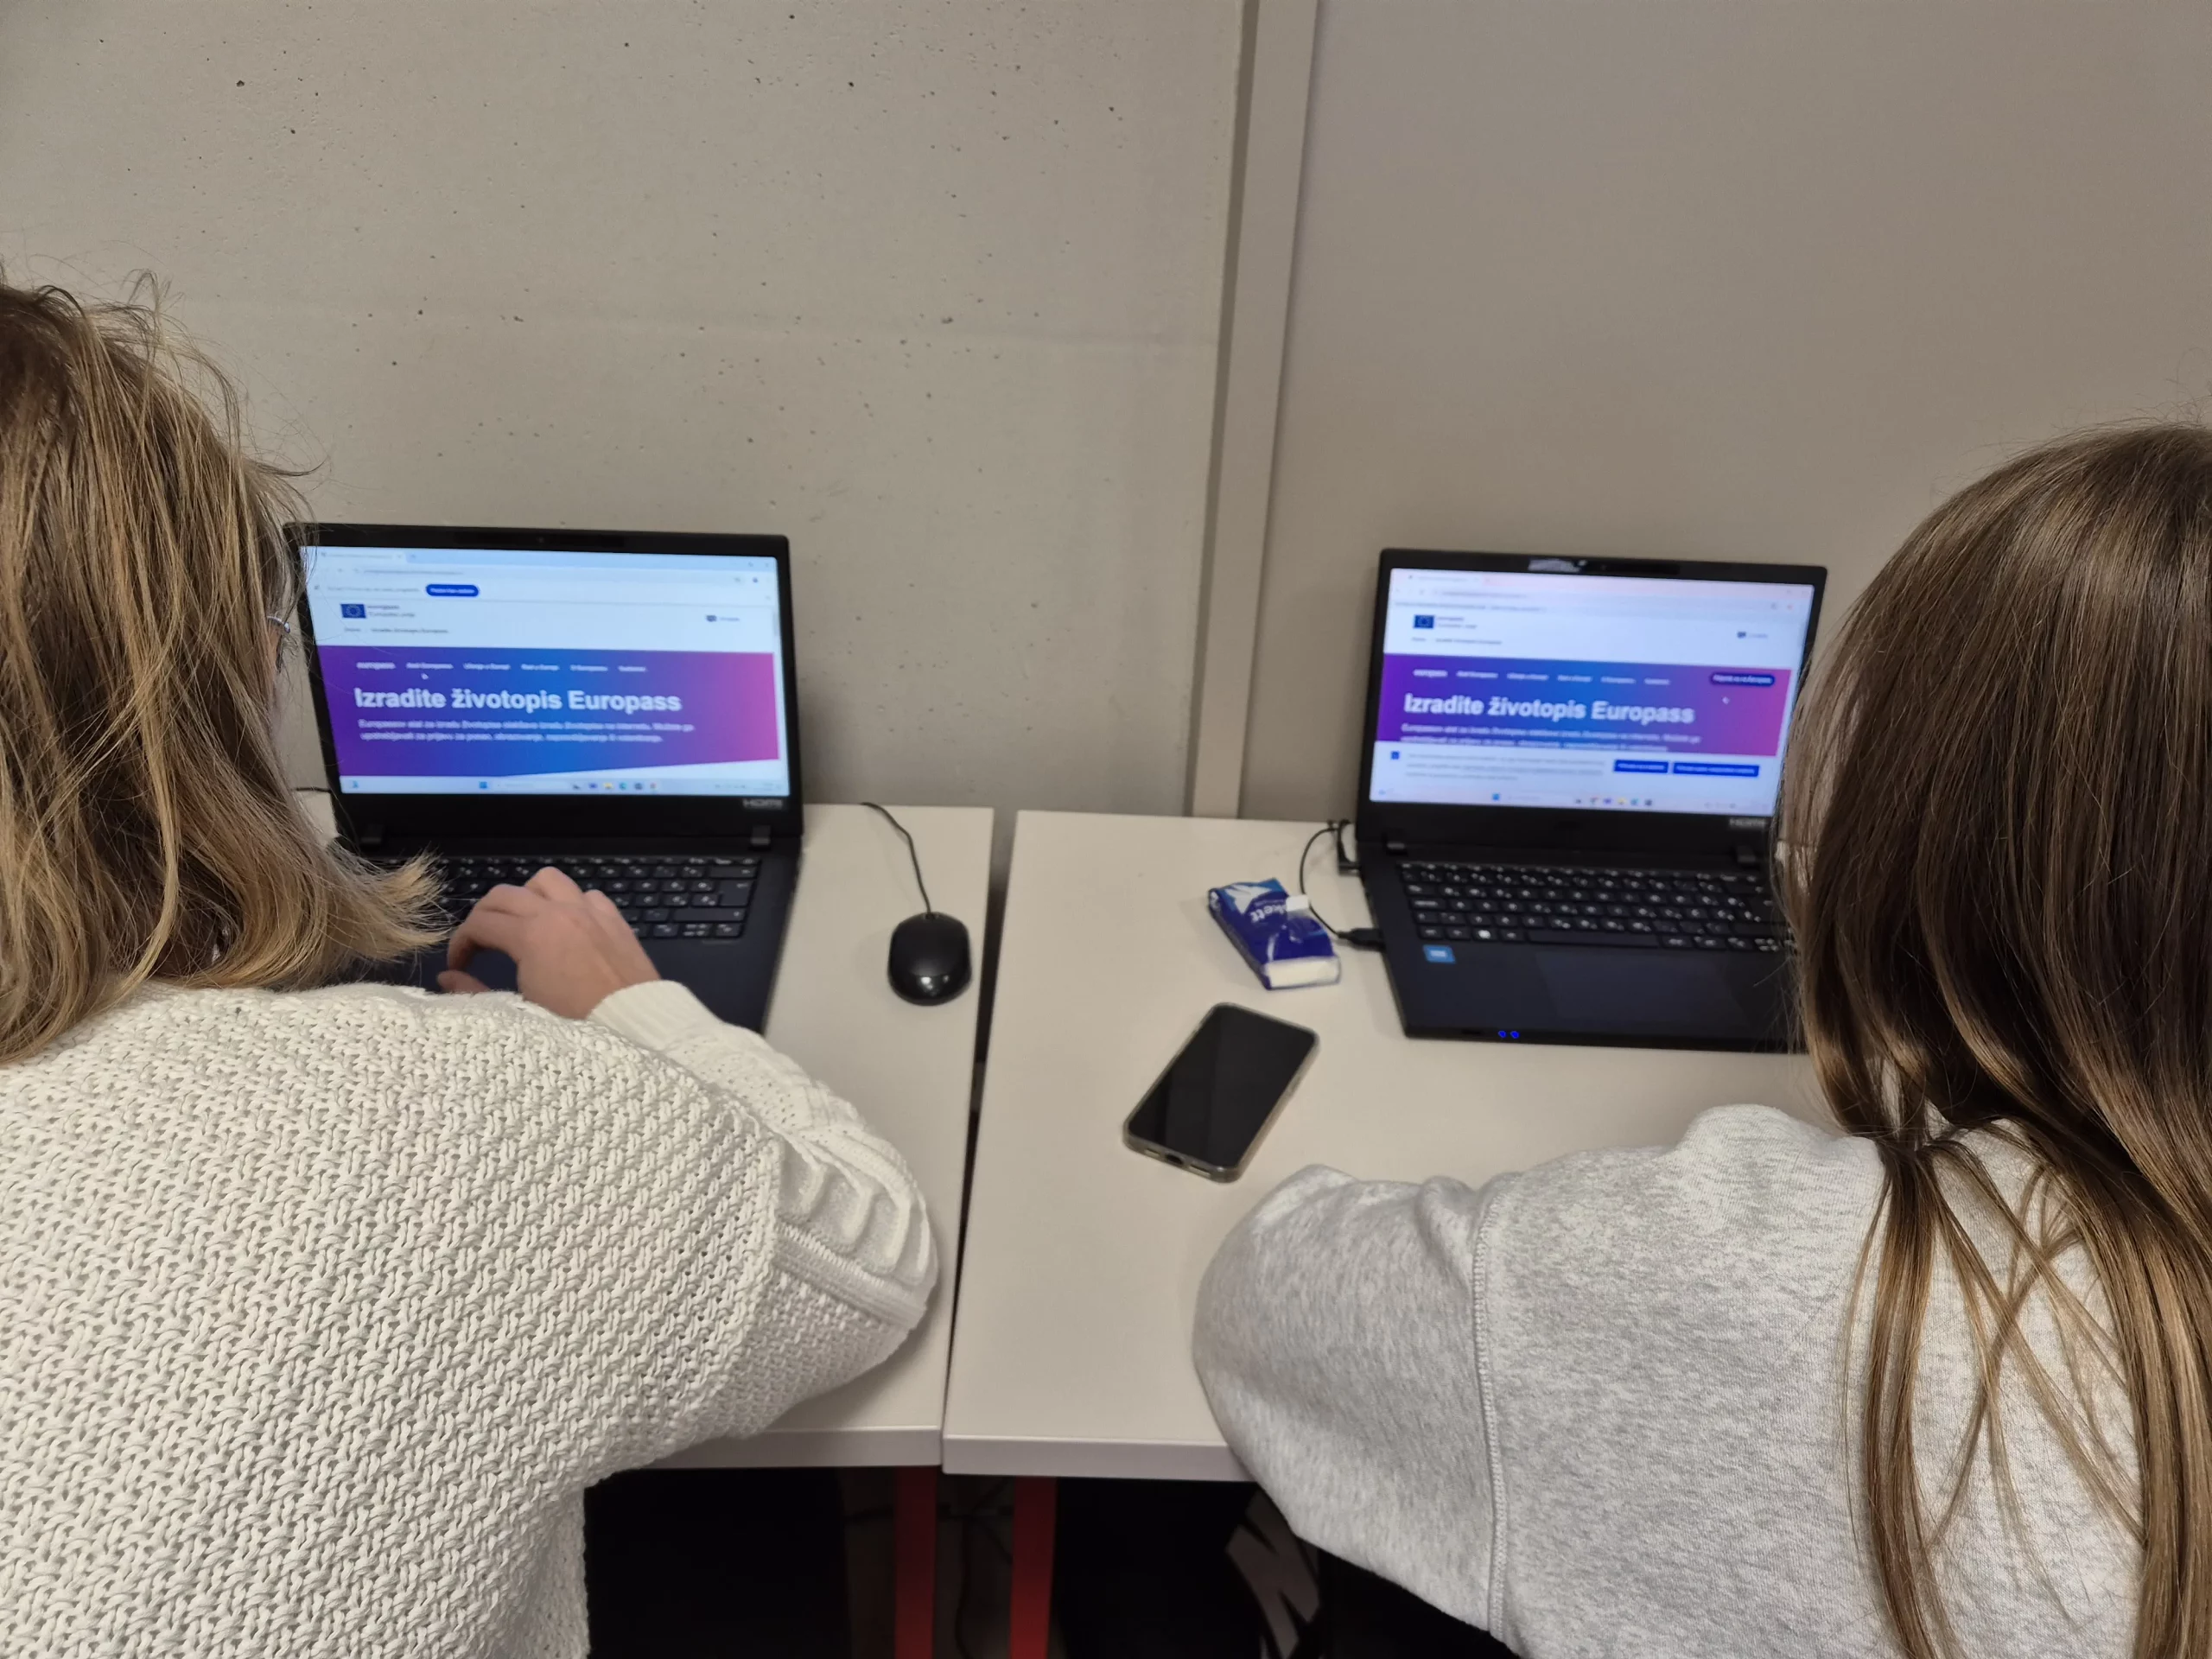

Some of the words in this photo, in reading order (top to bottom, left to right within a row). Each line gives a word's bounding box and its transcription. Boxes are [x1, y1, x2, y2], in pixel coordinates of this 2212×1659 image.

[353, 687, 447, 708] Izradite
[451, 688, 563, 714] životopis
[567, 690, 683, 715] Europass
[1403, 692, 1484, 715] Izradite
[1487, 696, 1586, 722] životopis
[1591, 700, 1695, 726] Europass
